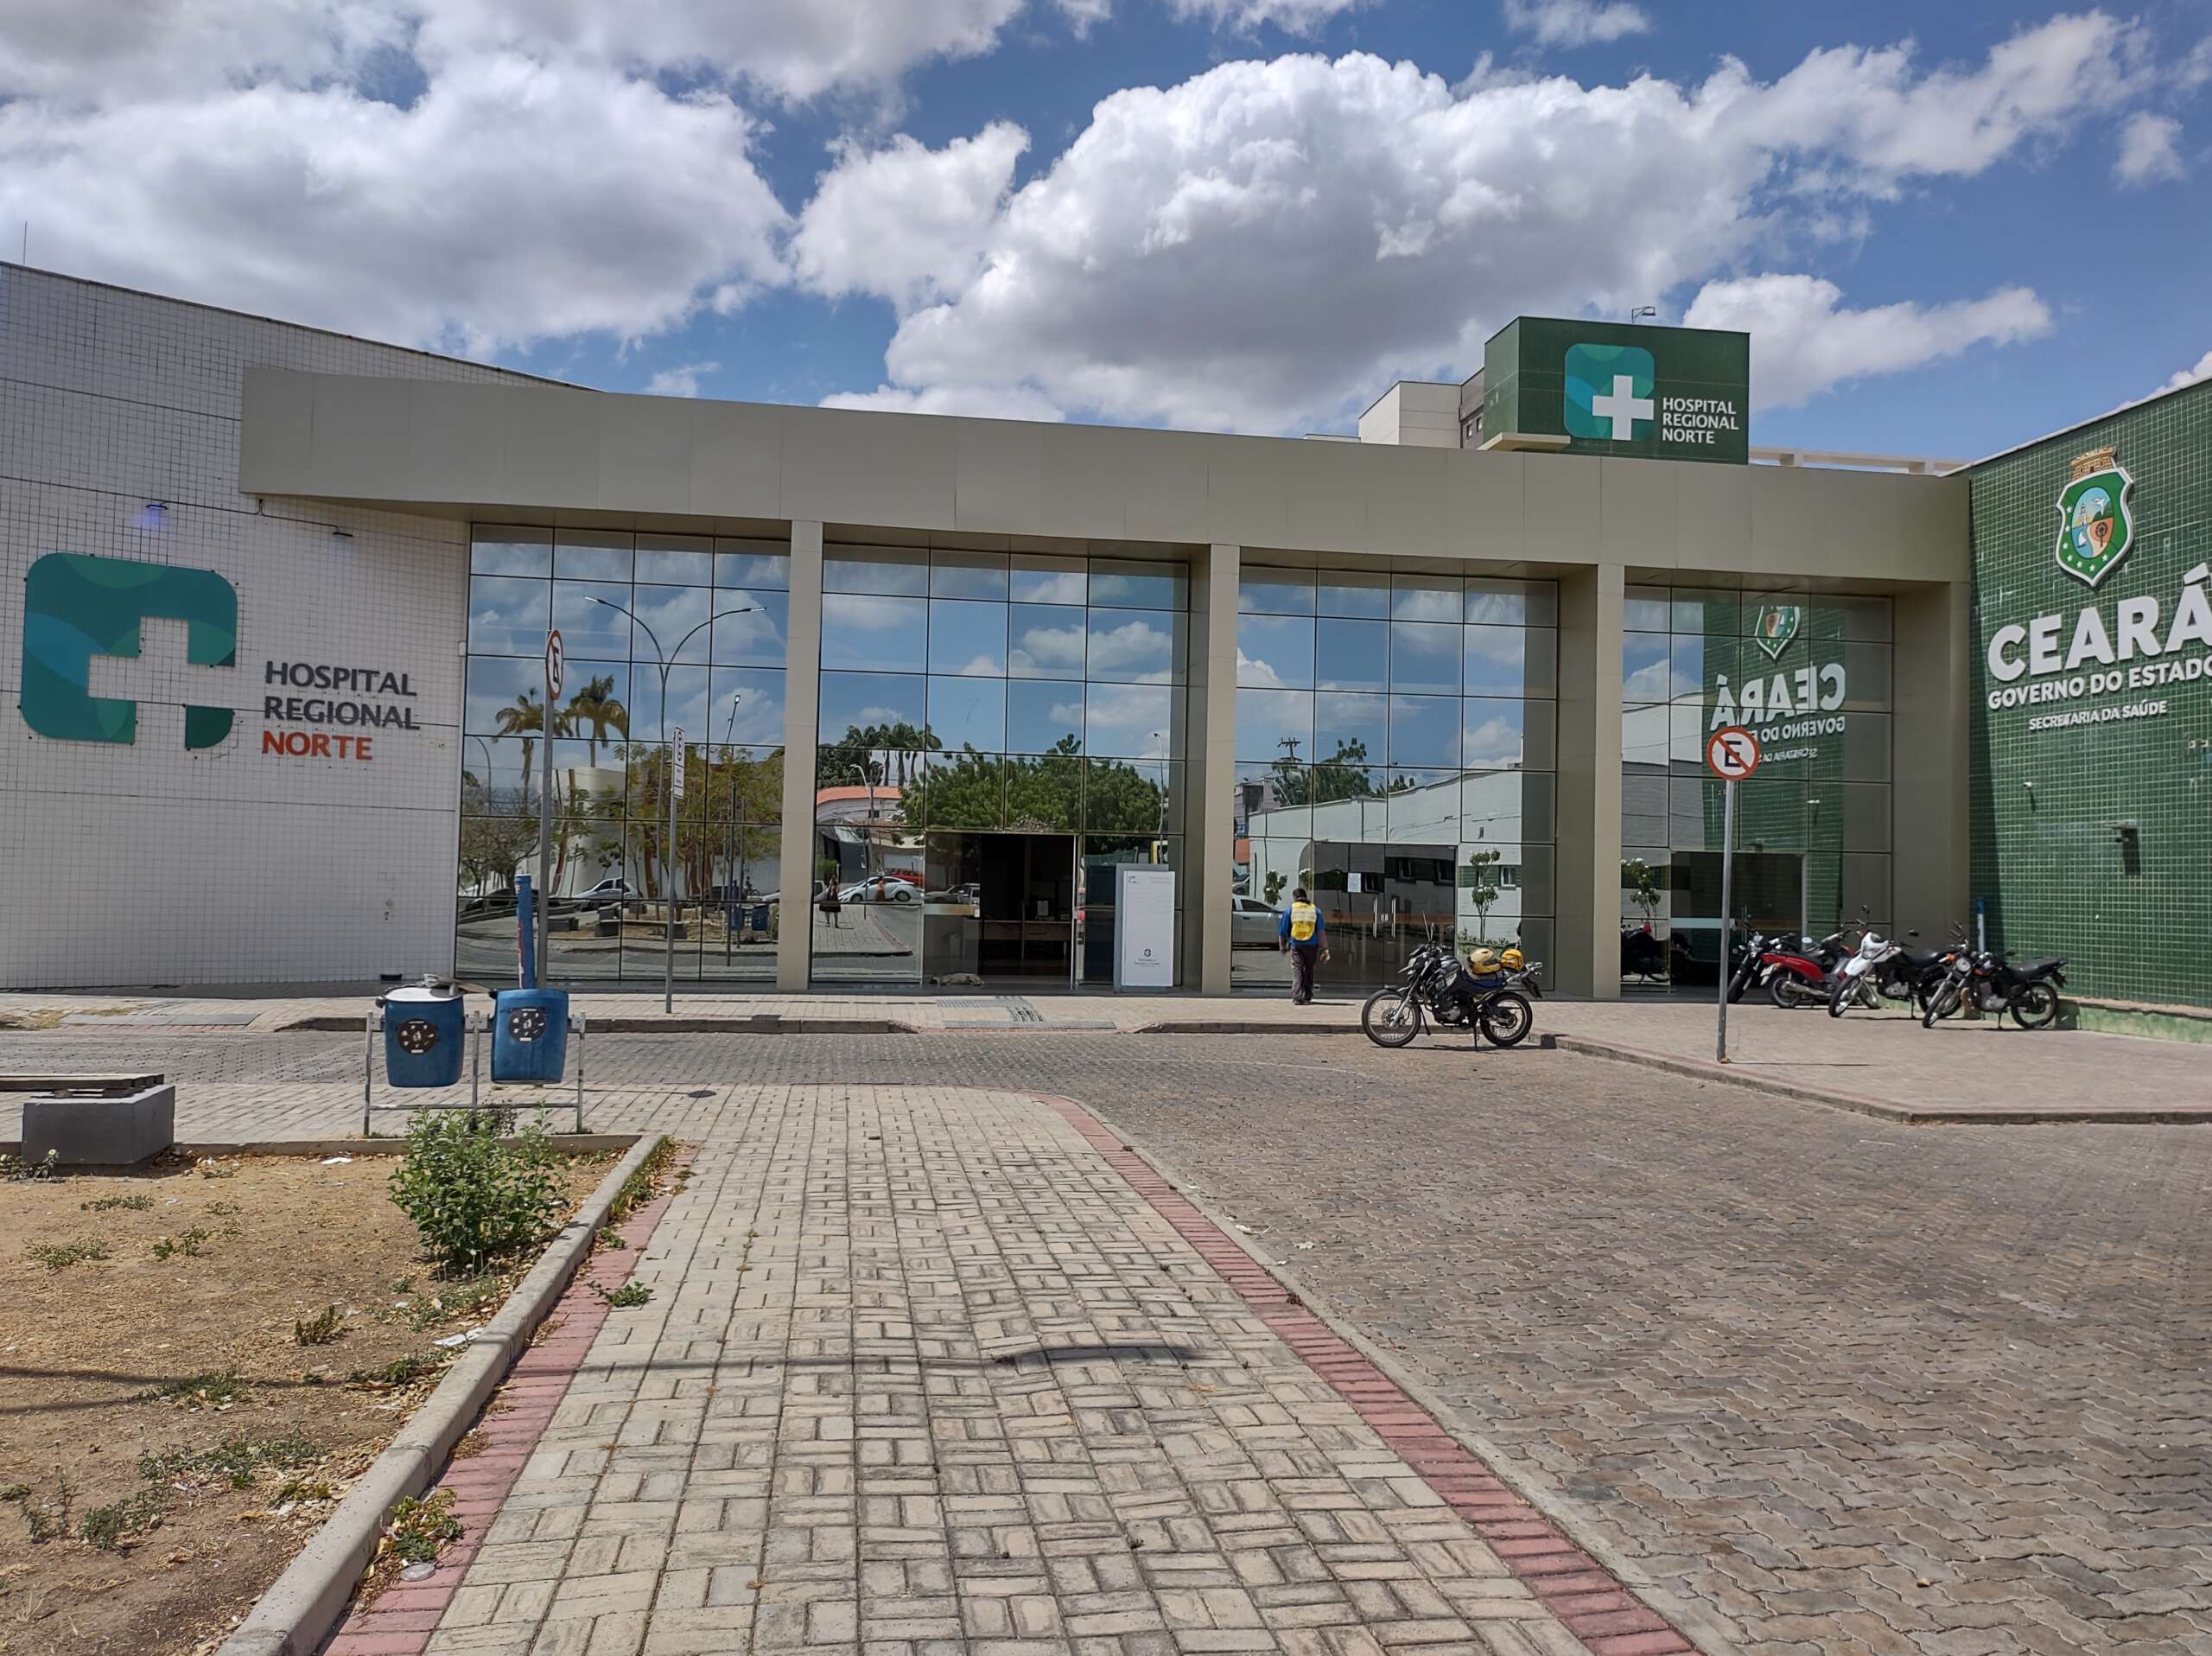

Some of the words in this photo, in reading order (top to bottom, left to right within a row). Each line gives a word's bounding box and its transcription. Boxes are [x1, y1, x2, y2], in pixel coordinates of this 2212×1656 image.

[1662, 397, 1736, 415] HOSPITAL
[1662, 412, 1739, 430] REGIONAL
[1662, 428, 1715, 444] NORTE
[1988, 562, 2212, 682] CEARÁ
[265, 660, 417, 697] HOSPITAL
[1988, 678, 2084, 710] GOVERNO
[2090, 671, 2123, 693] DO
[264, 696, 420, 730] REGIONAL
[2029, 709, 2100, 729] SECRETARIA
[2101, 705, 2120, 721] DA
[2122, 698, 2168, 718] SAÚDE
[262, 731, 373, 761] NORTE
